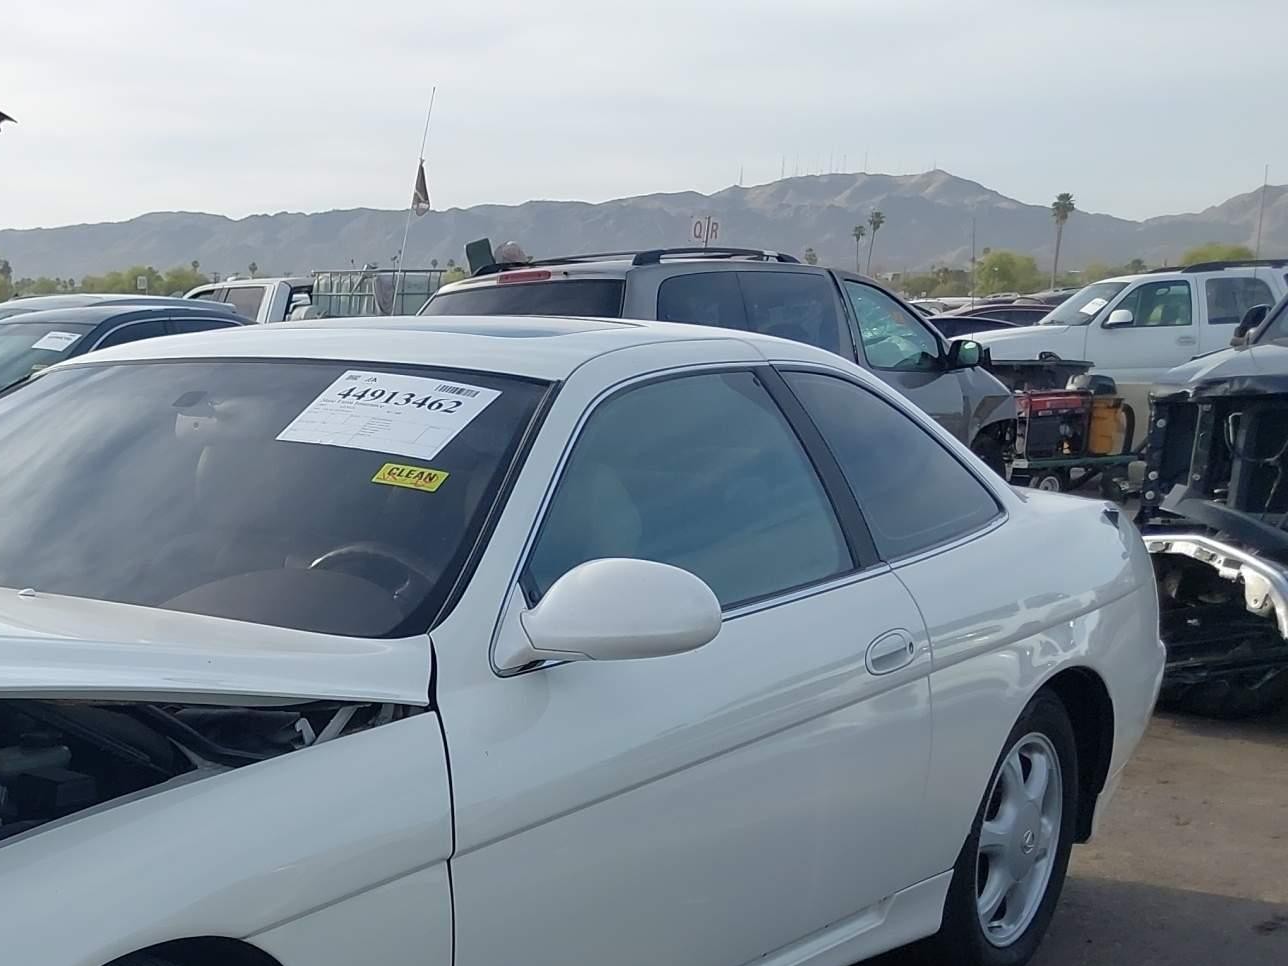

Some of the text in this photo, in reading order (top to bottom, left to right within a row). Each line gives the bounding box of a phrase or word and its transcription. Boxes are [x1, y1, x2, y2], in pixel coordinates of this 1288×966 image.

[693, 220, 719, 240] Q R
[337, 386, 463, 414] 44913462
[387, 467, 437, 484] CLEAN
